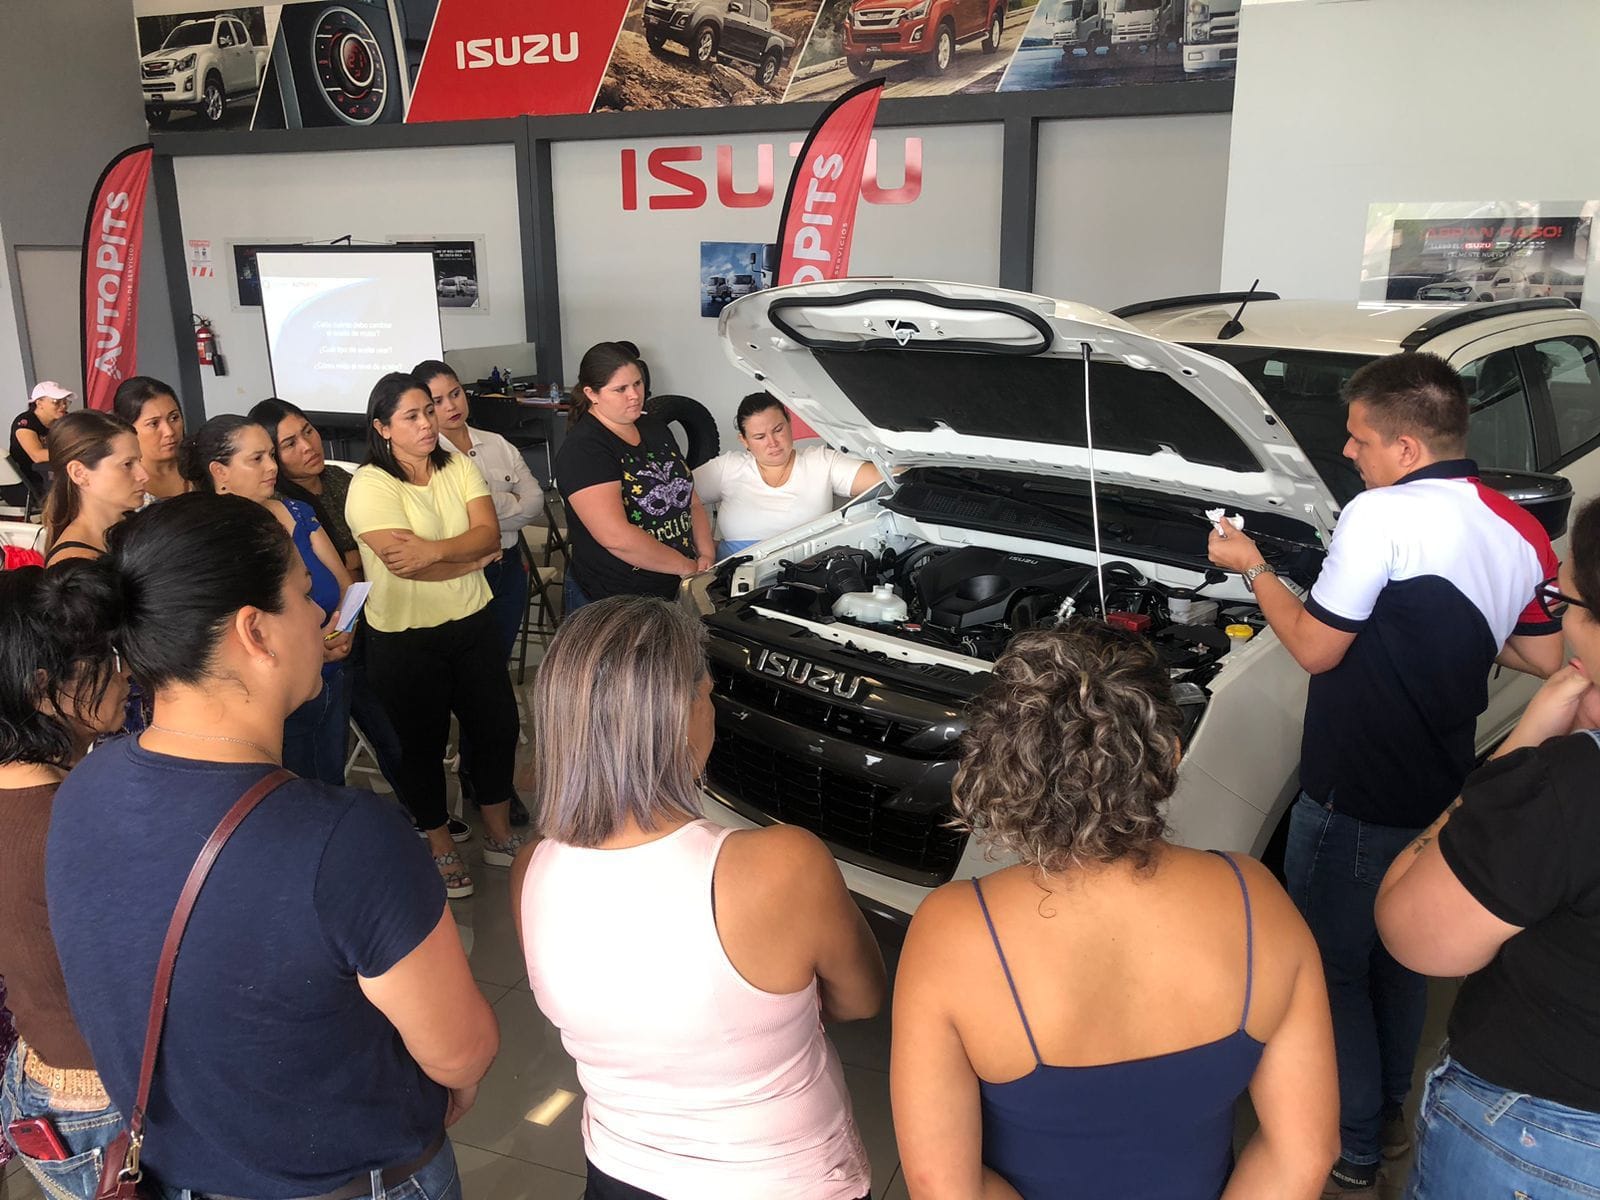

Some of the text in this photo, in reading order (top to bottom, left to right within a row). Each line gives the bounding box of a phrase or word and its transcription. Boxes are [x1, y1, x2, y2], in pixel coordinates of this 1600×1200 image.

[456, 32, 579, 69] ISUZU
[621, 137, 922, 210] ISUU
[835, 222, 848, 275] SERVICIOS
[1464, 242, 1492, 250] ISUZU
[1501, 225, 1564, 239] PASO!
[127, 243, 135, 283] SERVICIOS
[95, 191, 129, 380] AUTOPITS
[1009, 556, 1039, 565] ISUZU
[756, 649, 861, 699] ISUZU
